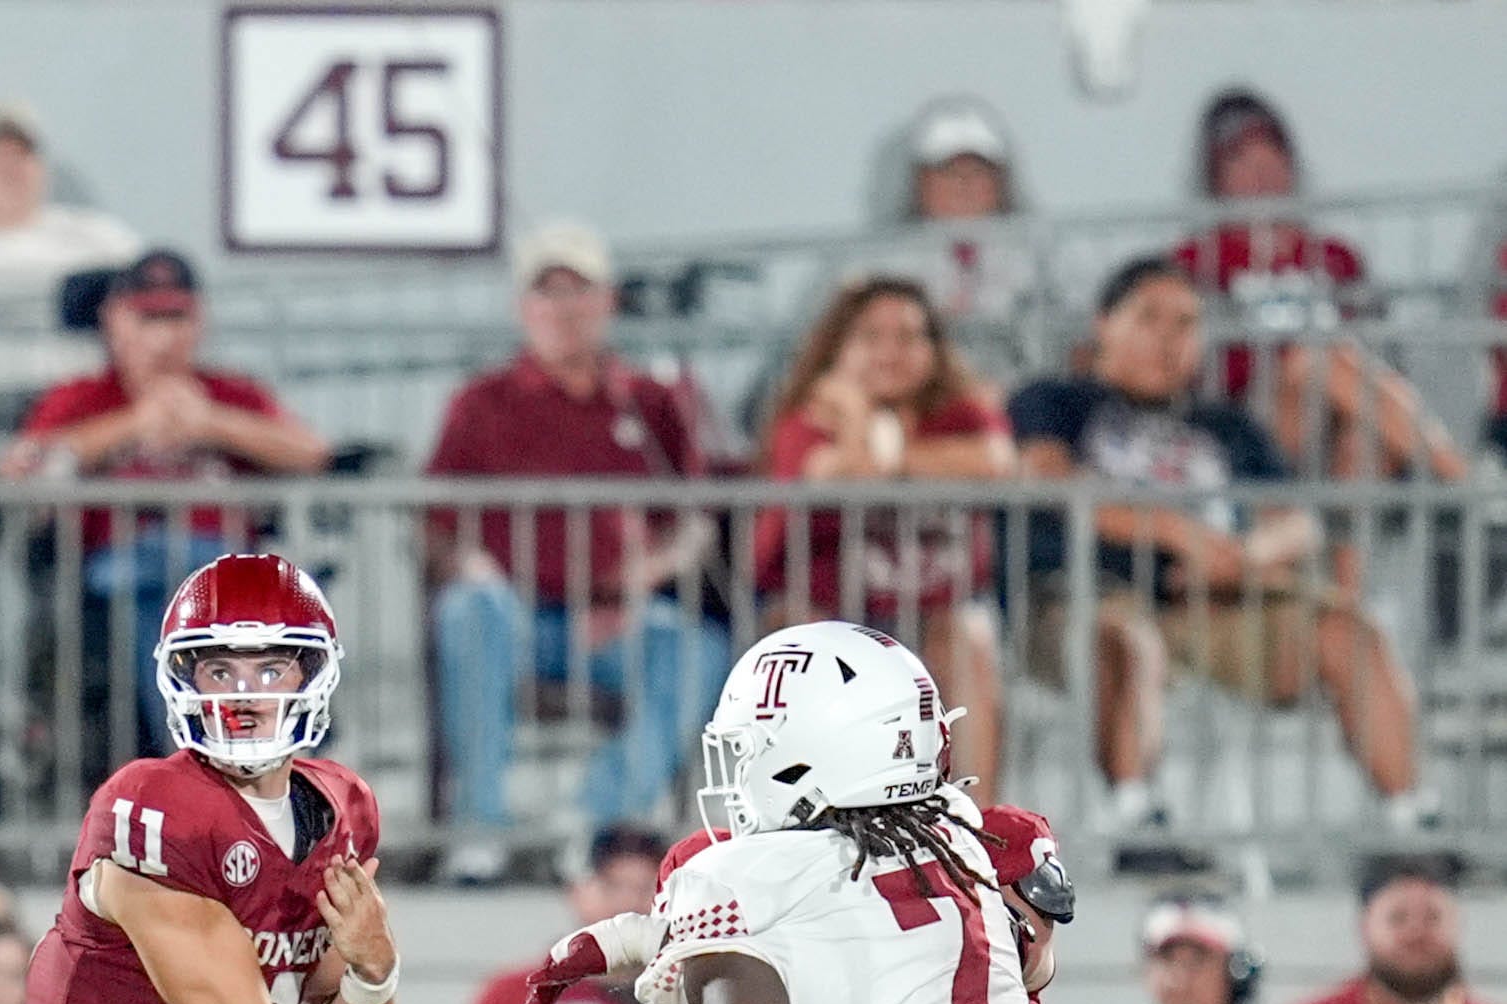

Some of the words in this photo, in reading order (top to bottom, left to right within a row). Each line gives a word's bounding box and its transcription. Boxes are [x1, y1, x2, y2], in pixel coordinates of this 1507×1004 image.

[273, 60, 449, 199] 45
[884, 779, 934, 799] TEMP
[111, 797, 168, 877] 11
[225, 845, 258, 884] SEC
[244, 926, 334, 967] ONER
